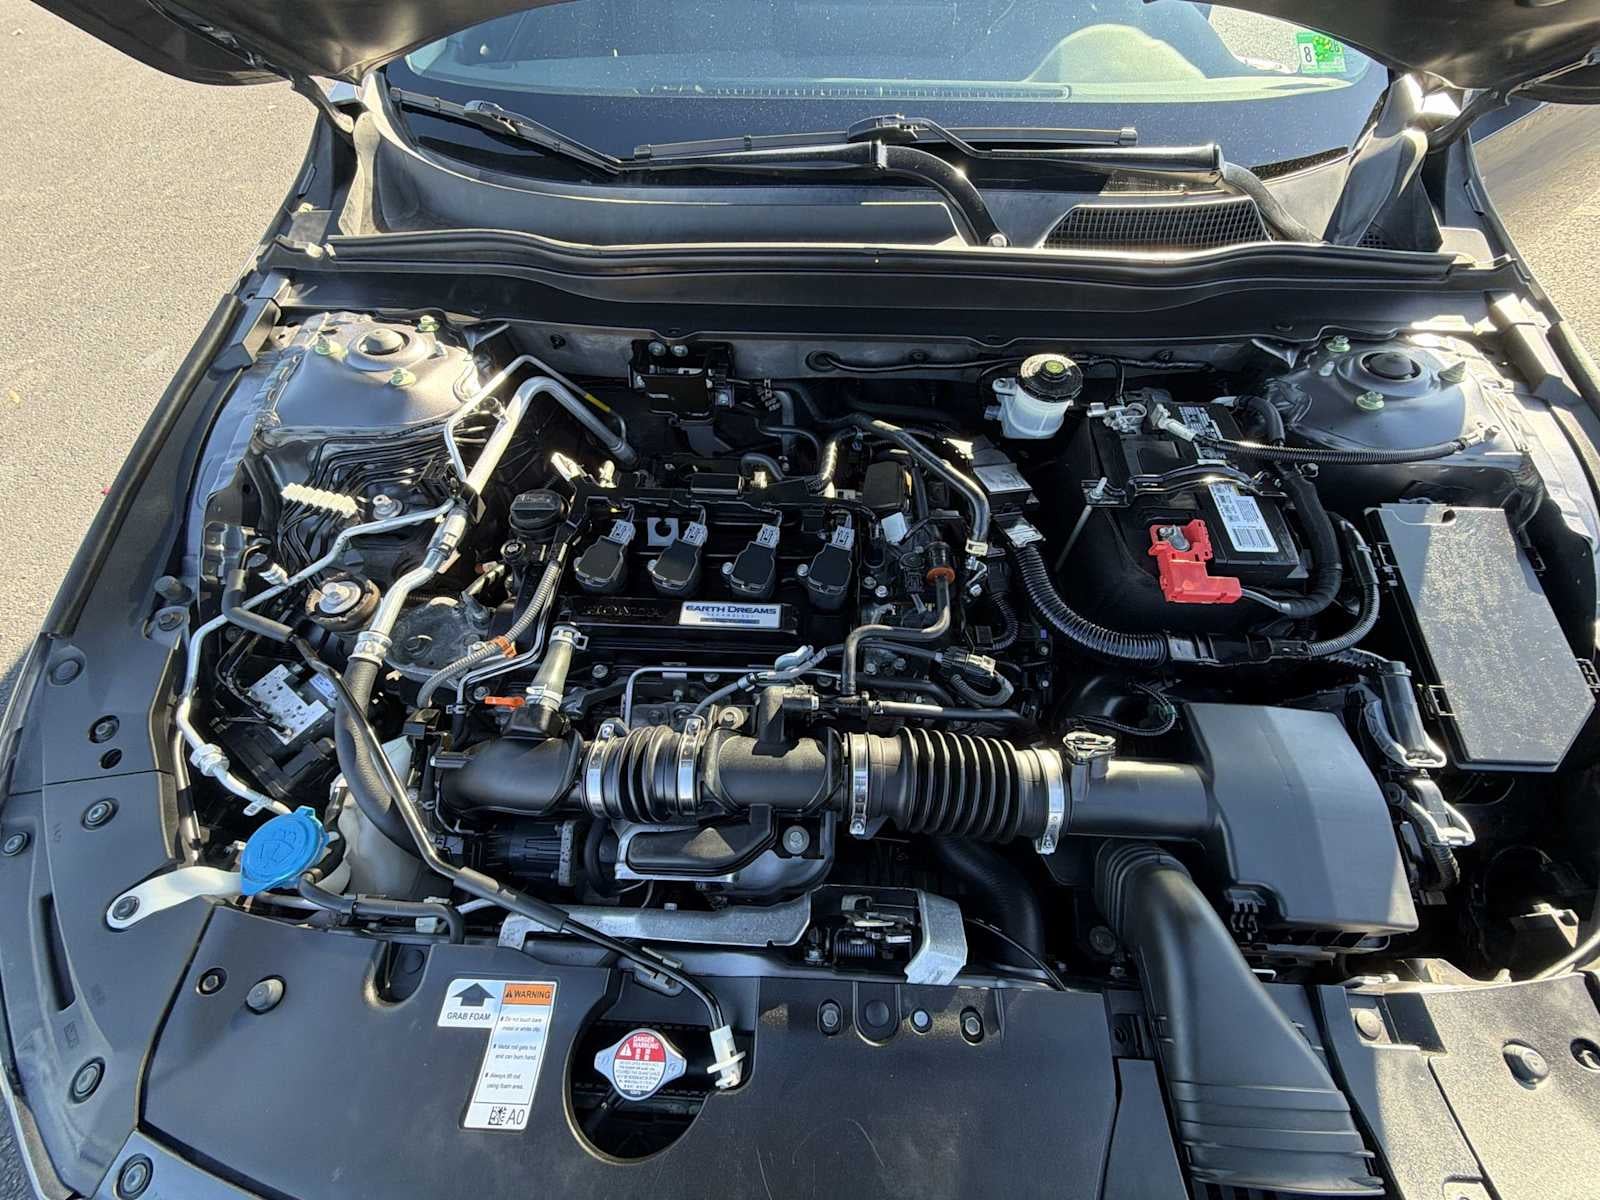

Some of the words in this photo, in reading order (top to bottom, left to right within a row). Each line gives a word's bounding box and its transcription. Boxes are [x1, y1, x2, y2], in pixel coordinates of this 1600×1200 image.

[1303, 46, 1313, 63] 8
[685, 605, 726, 613] EARTH
[727, 605, 777, 614] DREAMS
[513, 989, 551, 1000] WARNING
[446, 1011, 468, 1021] GRAB
[468, 1012, 491, 1021] FOAM
